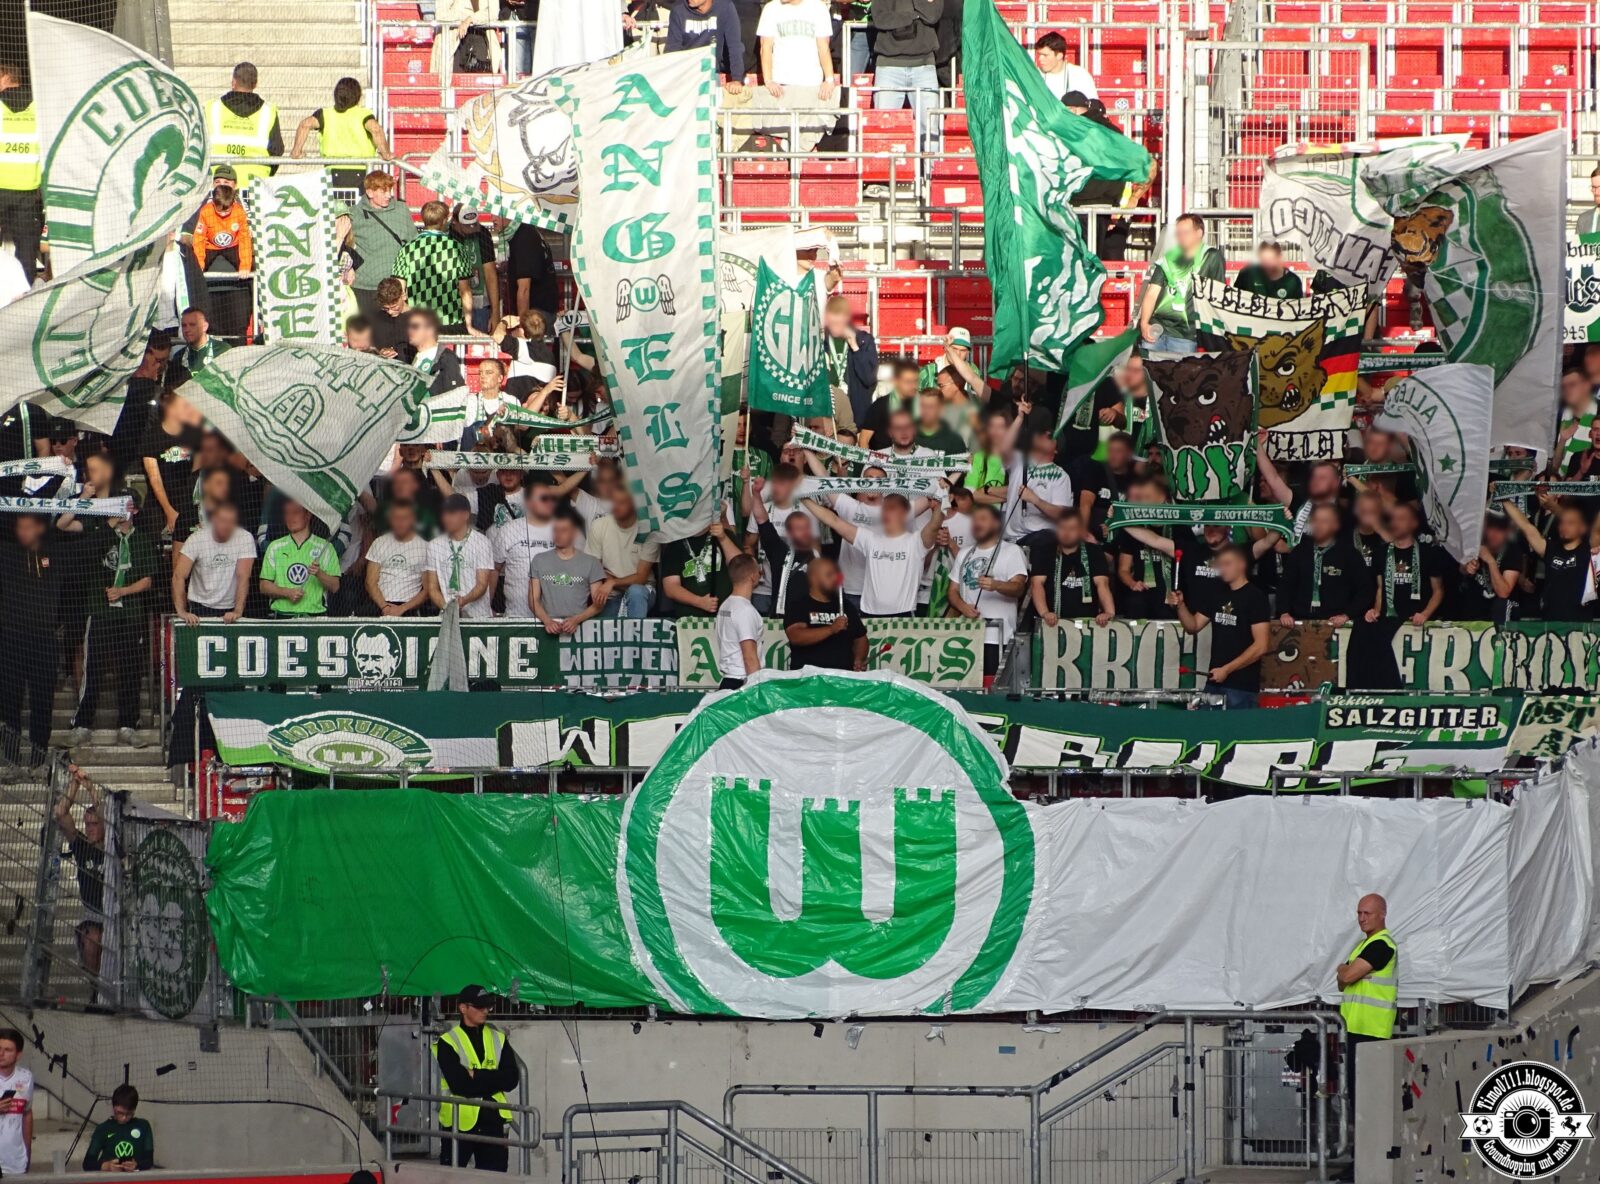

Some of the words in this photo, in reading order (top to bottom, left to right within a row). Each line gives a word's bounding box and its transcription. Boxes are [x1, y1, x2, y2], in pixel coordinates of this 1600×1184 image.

[5, 142, 30, 154] 2466
[226, 144, 246, 155] 0206
[265, 185, 322, 339] ANGE
[600, 73, 703, 523] ANGELS
[772, 392, 801, 405] SINCE
[454, 452, 572, 466] ANGELS
[817, 478, 932, 491] ANGELS
[559, 646, 678, 671] WAPPEN
[1326, 695, 1384, 706] Sektion
[1328, 706, 1498, 728] SALZGITTER
